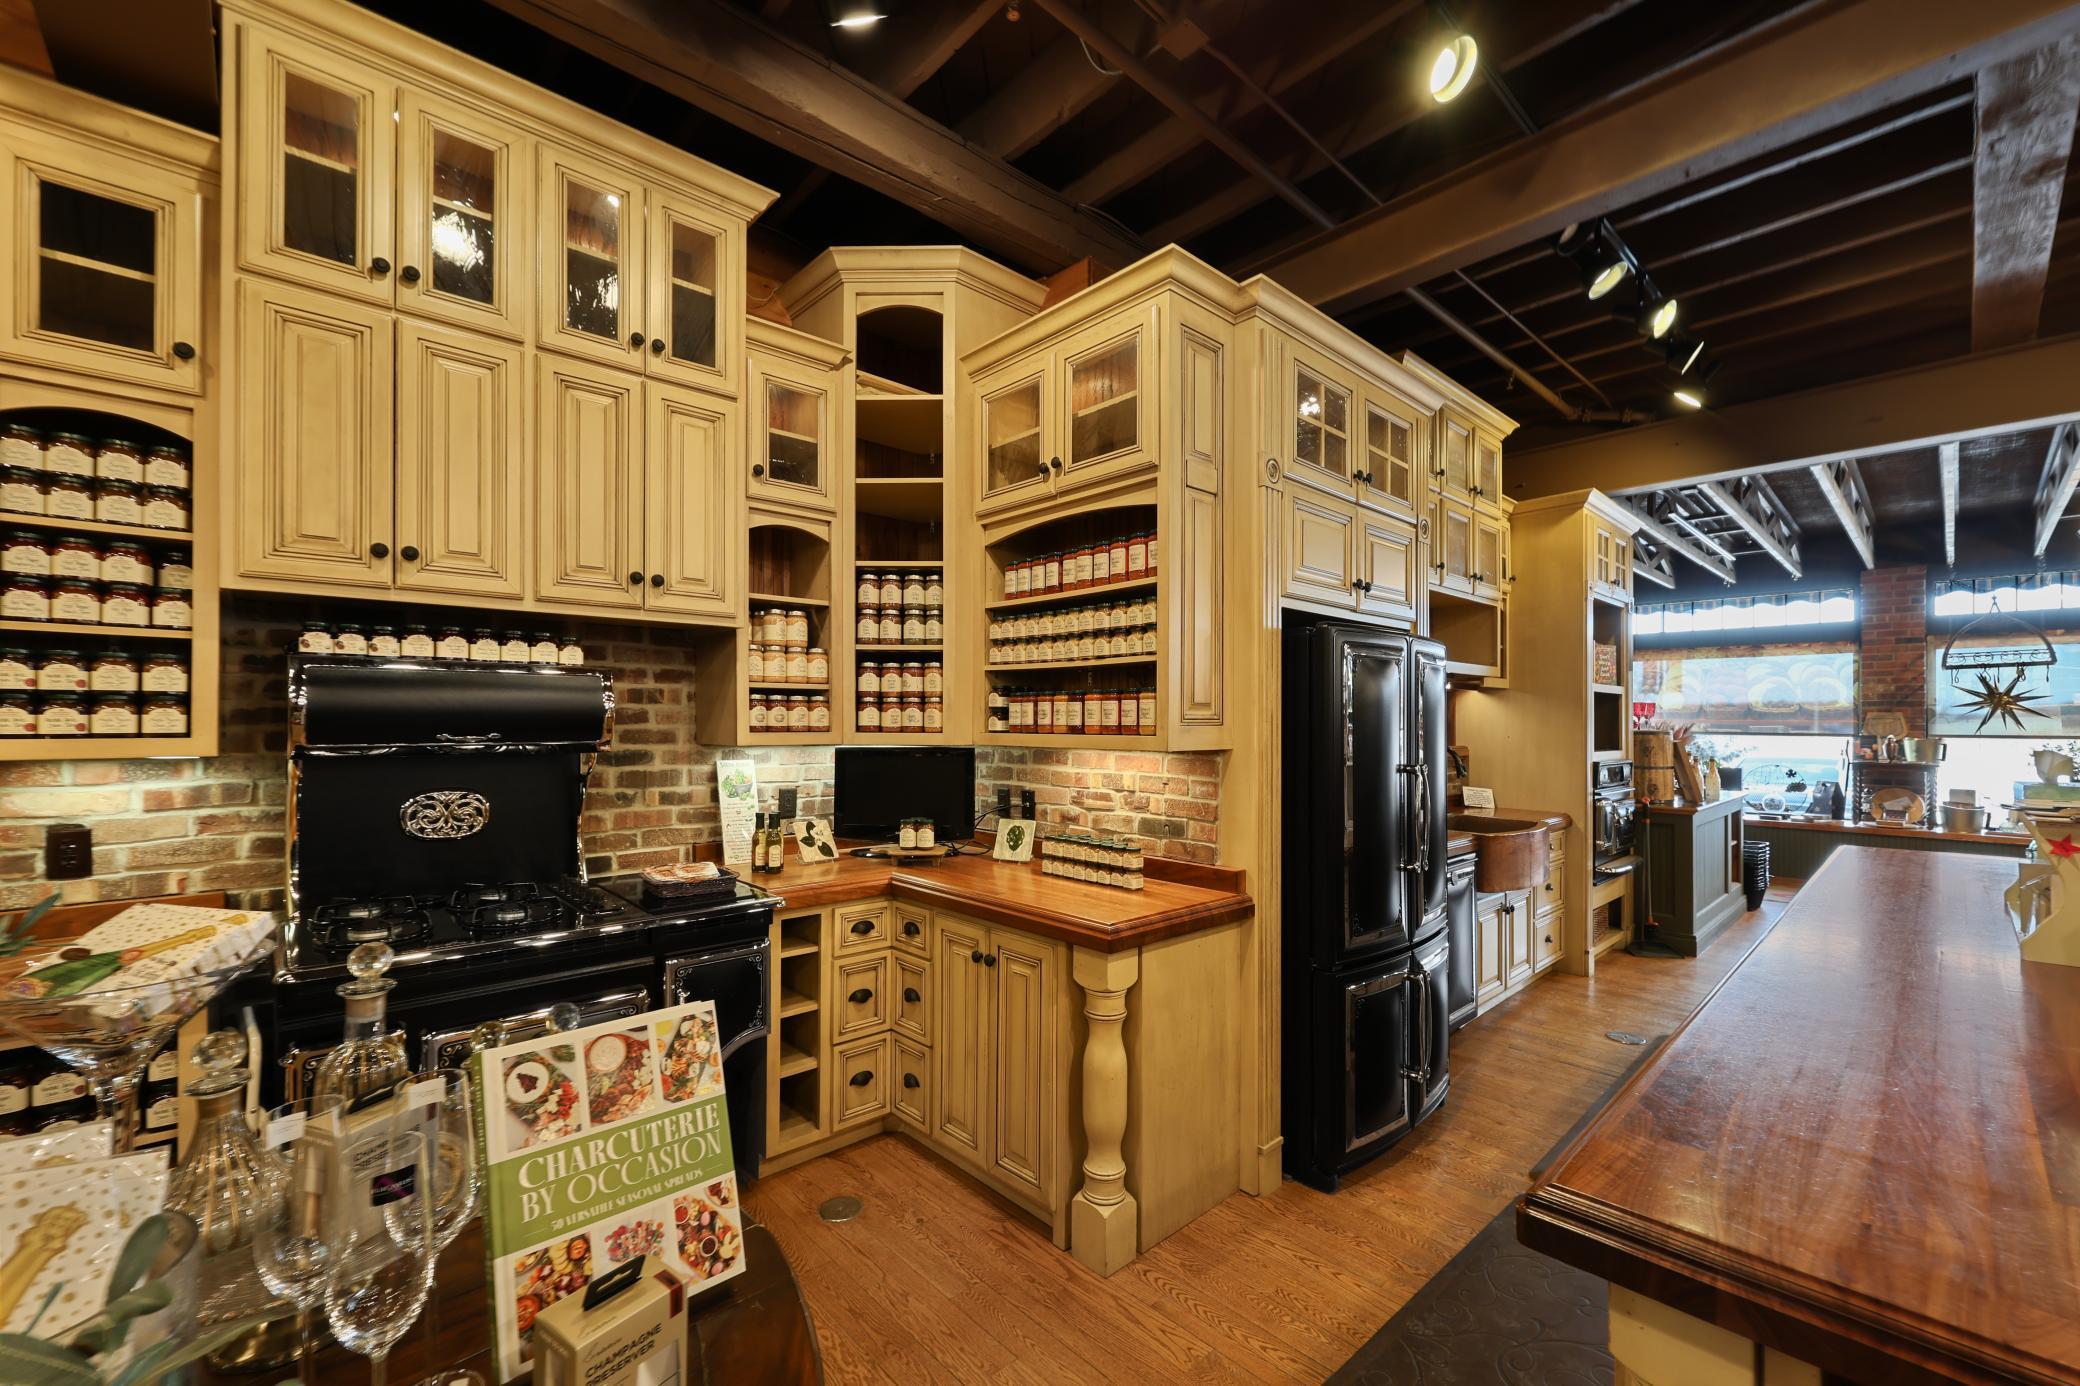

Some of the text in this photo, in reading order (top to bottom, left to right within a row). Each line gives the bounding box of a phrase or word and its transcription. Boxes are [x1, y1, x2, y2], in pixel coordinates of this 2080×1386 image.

[518, 1103, 720, 1188] CHARCUTERIE
[520, 1129, 722, 1223] BY OCCASION
[565, 1200, 614, 1226] VERSATILE
[615, 1183, 662, 1206] SEASONAL
[664, 1168, 703, 1189] SPREADS
[585, 1322, 664, 1378] CHAMPAGNE
